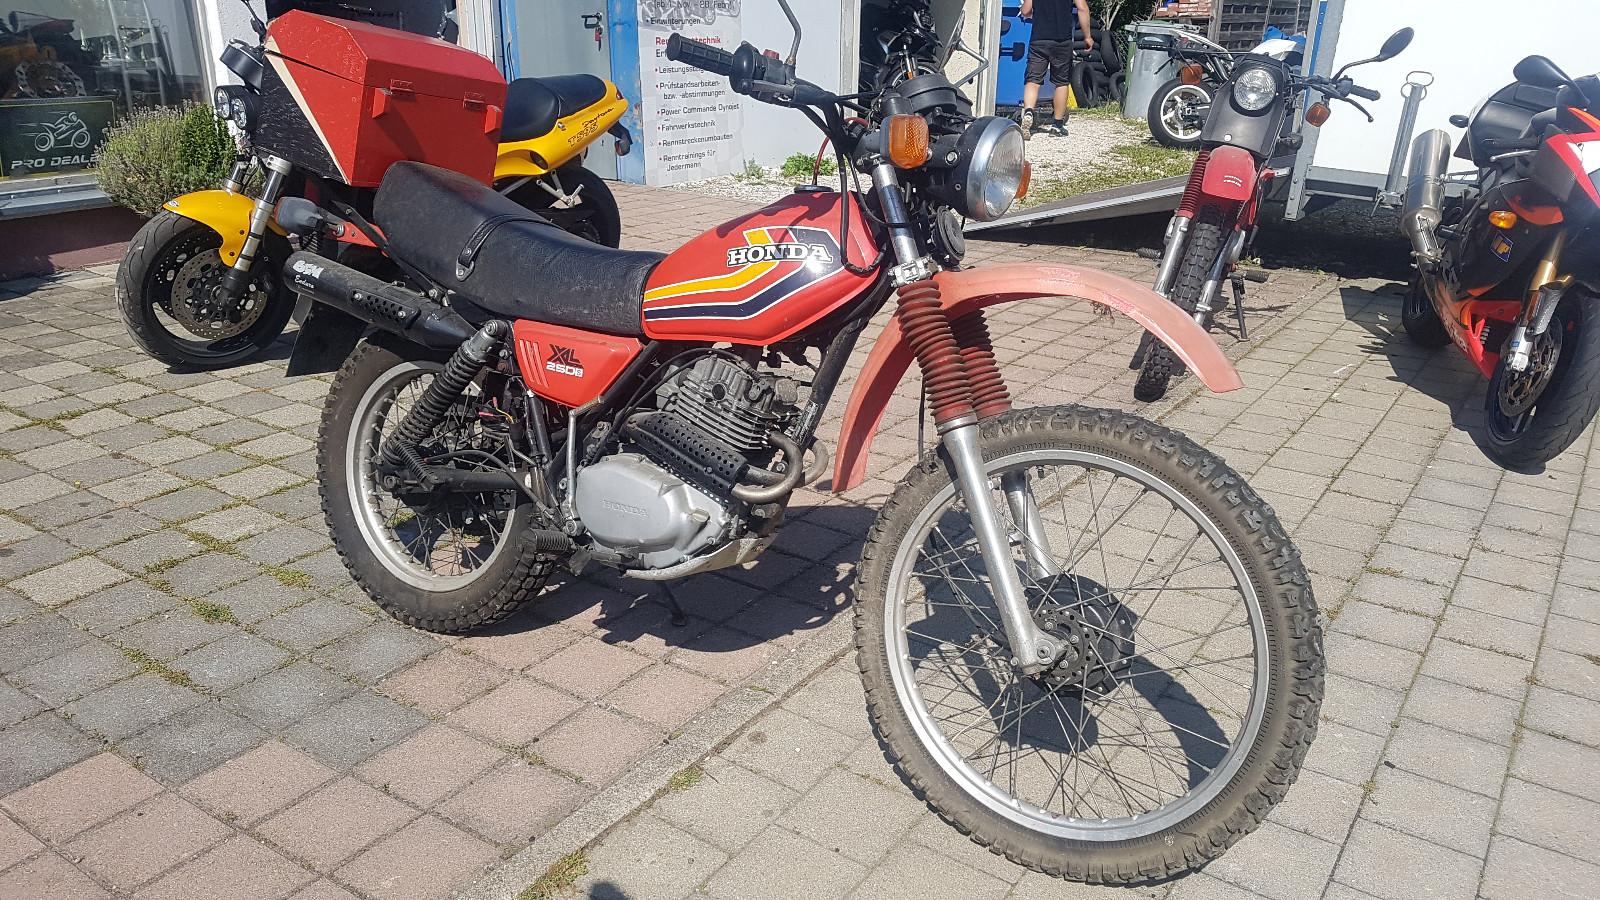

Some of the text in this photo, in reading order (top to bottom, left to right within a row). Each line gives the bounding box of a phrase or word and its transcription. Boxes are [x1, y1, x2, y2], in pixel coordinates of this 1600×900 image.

[650, 17, 701, 26] Einwinterungen
[663, 92, 678, 100] bzw.
[660, 108, 682, 116] Power
[718, 101, 740, 112] Dynojet
[661, 120, 716, 132] Fahrwerkstechnik
[662, 133, 733, 147] Rennstreckenumbauten
[663, 149, 717, 162] Renntrainings für
[11, 158, 45, 169] PRO
[666, 162, 702, 172] Jedermann
[727, 242, 834, 267] HONDA
[546, 343, 584, 369] XL
